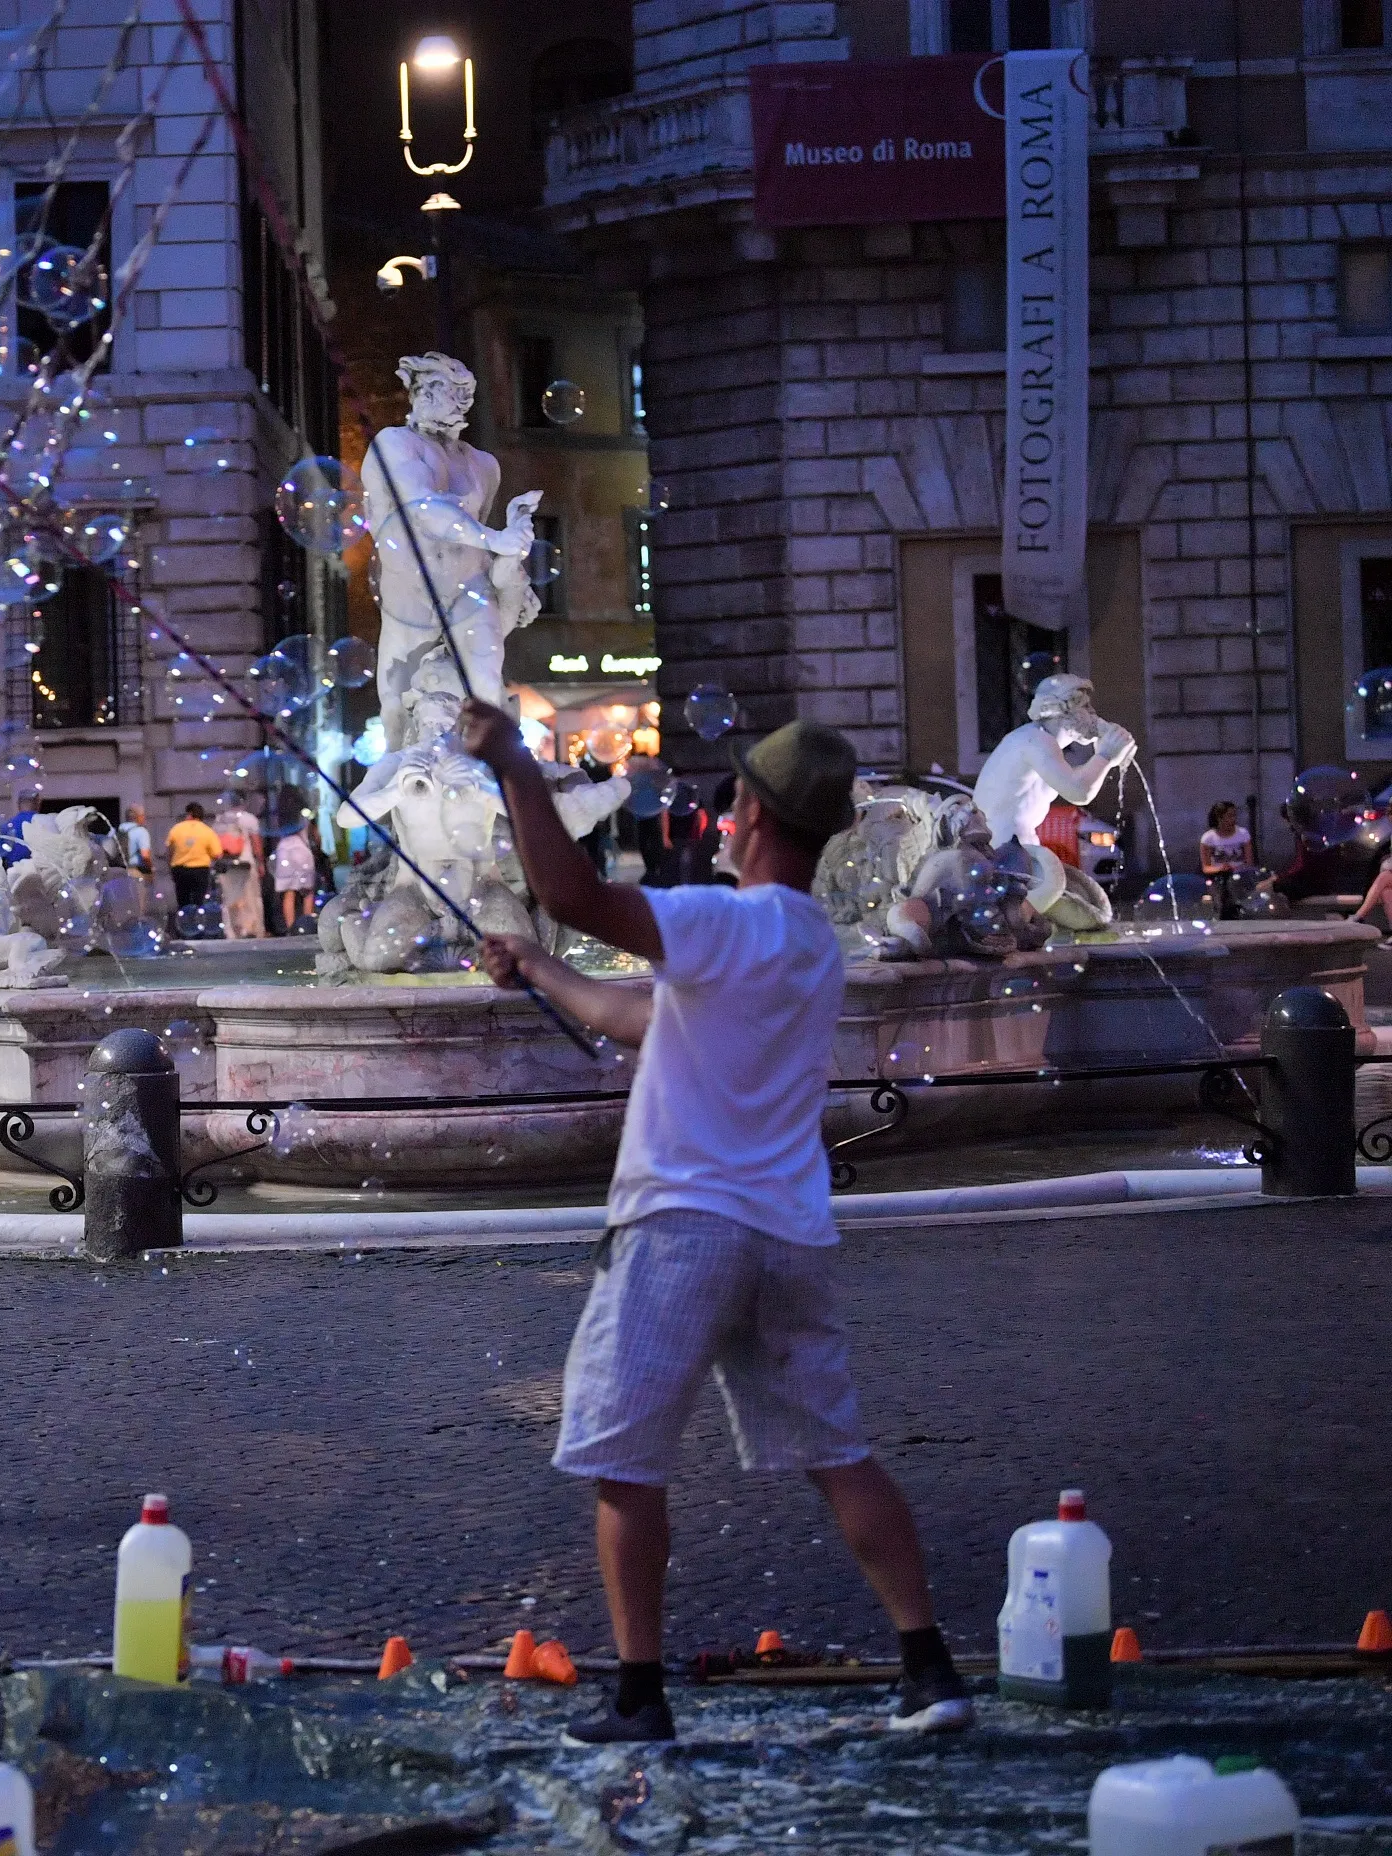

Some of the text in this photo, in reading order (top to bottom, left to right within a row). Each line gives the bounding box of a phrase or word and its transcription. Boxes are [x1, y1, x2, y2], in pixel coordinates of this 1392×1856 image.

[784, 138, 973, 166] Museo di Roma
[1020, 82, 1054, 221] ROMA
[1021, 246, 1054, 273] A
[1018, 294, 1054, 553] FOTOGRAFI
